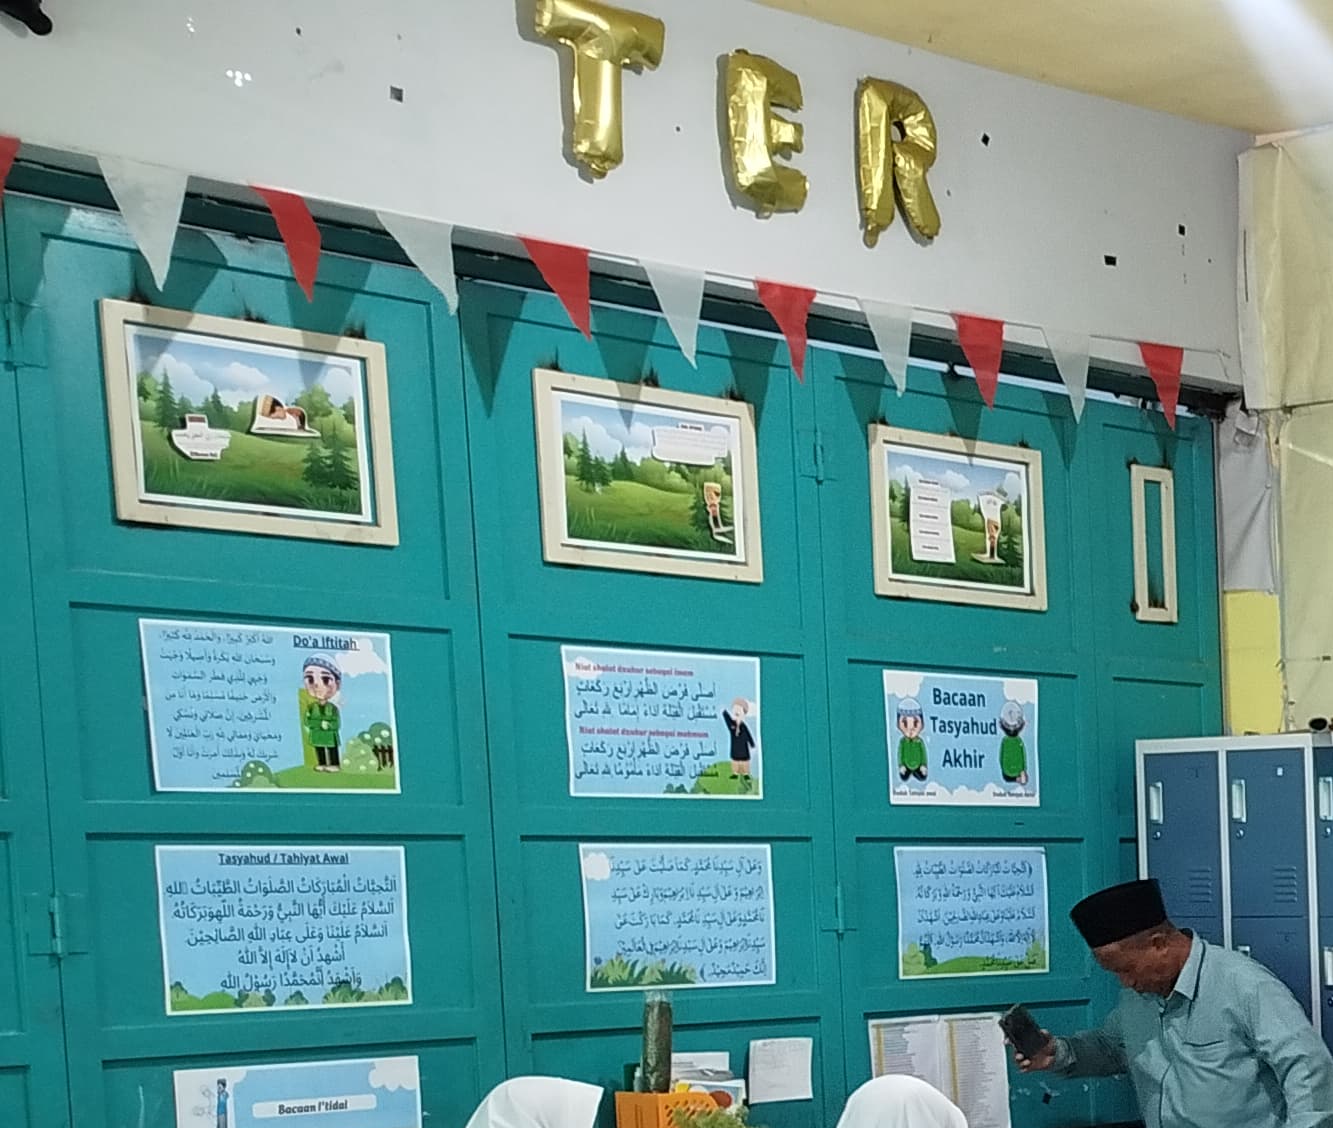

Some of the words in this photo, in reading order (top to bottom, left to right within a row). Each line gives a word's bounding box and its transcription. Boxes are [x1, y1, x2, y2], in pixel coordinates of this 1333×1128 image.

[535, 0, 941, 248] TER
[293, 635, 319, 649] Do'a
[321, 636, 359, 651] Iftitah
[932, 687, 986, 708] Bacaan
[930, 716, 997, 739] Tasyahud
[942, 748, 985, 769] Akhir
[218, 852, 271, 864] Tasyahud
[280, 853, 322, 864] Tahiyat
[323, 853, 349, 864] Awal
[278, 1103, 316, 1116] Bacaan
[318, 1100, 348, 1113] I'tidal
